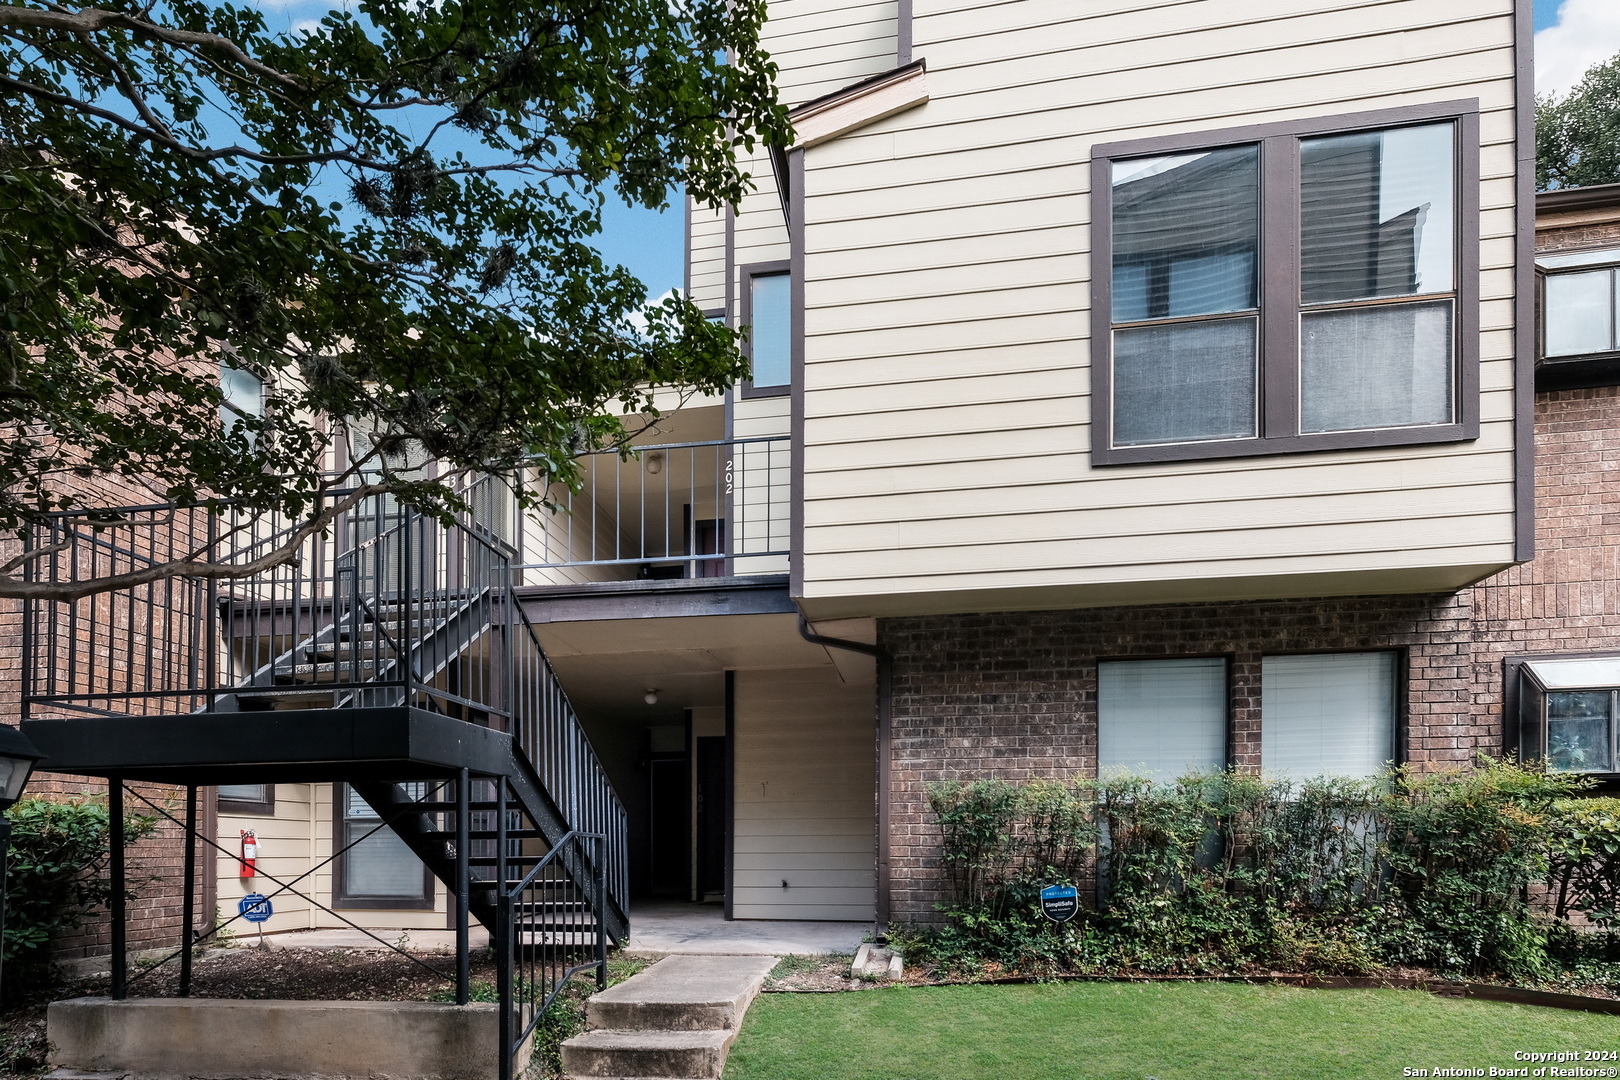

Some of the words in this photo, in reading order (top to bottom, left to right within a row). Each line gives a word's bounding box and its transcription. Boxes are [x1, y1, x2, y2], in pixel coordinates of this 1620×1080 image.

[725, 460, 733, 495] 202
[246, 902, 268, 914] ADT
[1045, 900, 1074, 908] SimpliSafe
